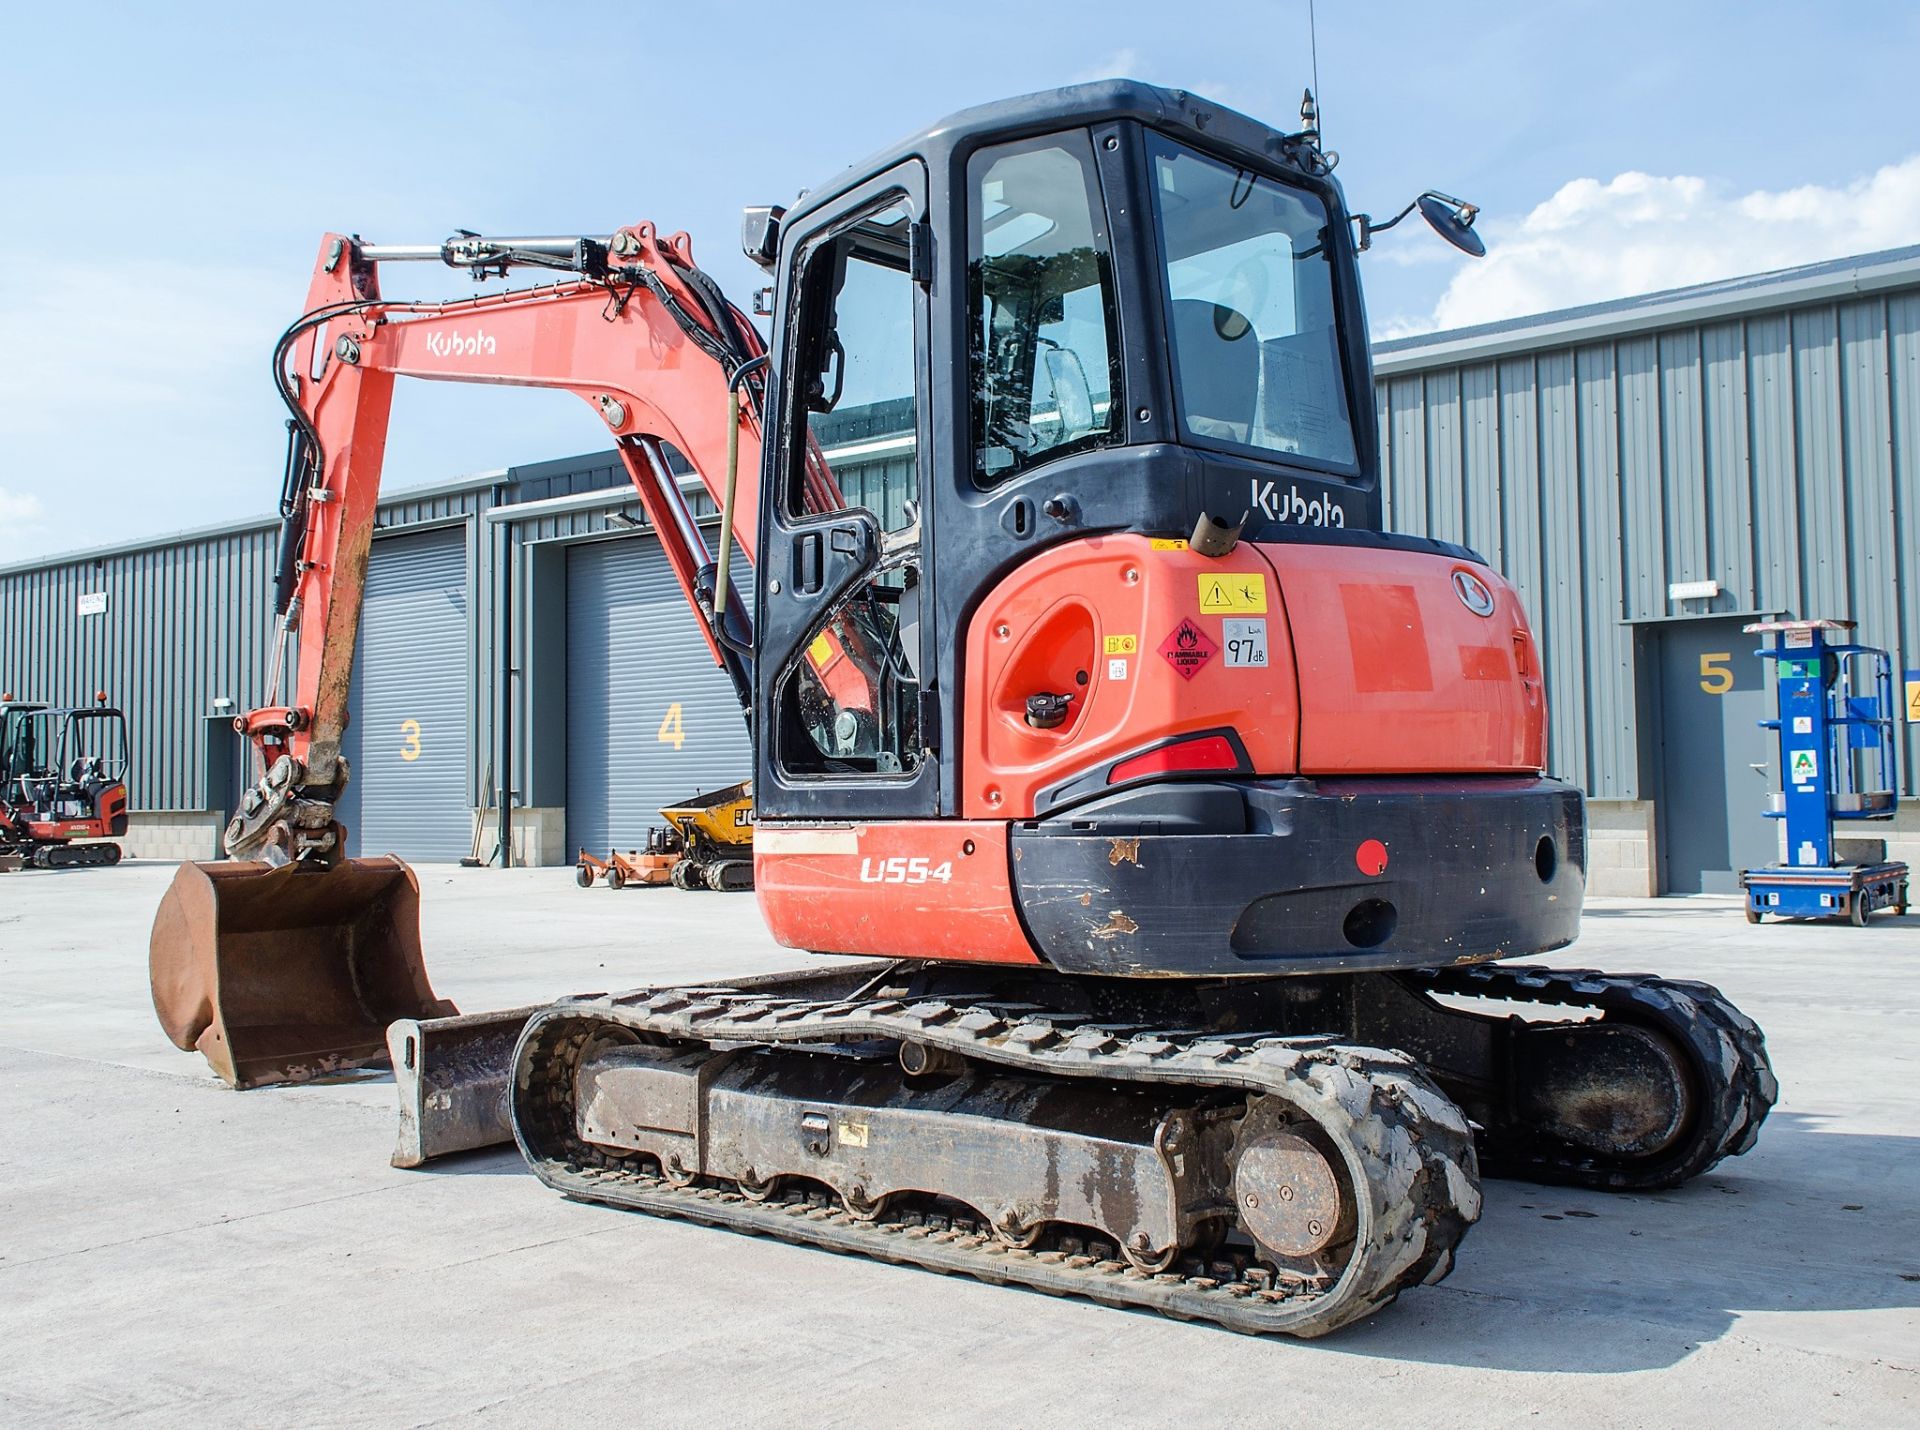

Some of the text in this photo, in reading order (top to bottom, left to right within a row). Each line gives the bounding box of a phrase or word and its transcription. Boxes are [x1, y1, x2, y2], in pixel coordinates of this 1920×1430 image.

[426, 328, 496, 357] Kubota
[1251, 478, 1344, 528] Kubota
[1167, 651, 1208, 659] FLAMMABLE
[1177, 658, 1199, 666] LIQUID
[1185, 667, 1191, 675] 3
[1700, 653, 1733, 694] 5
[400, 719, 421, 761] 3
[658, 703, 685, 750] 4
[1795, 753, 1813, 768] A
[860, 857, 952, 884] U55-4
